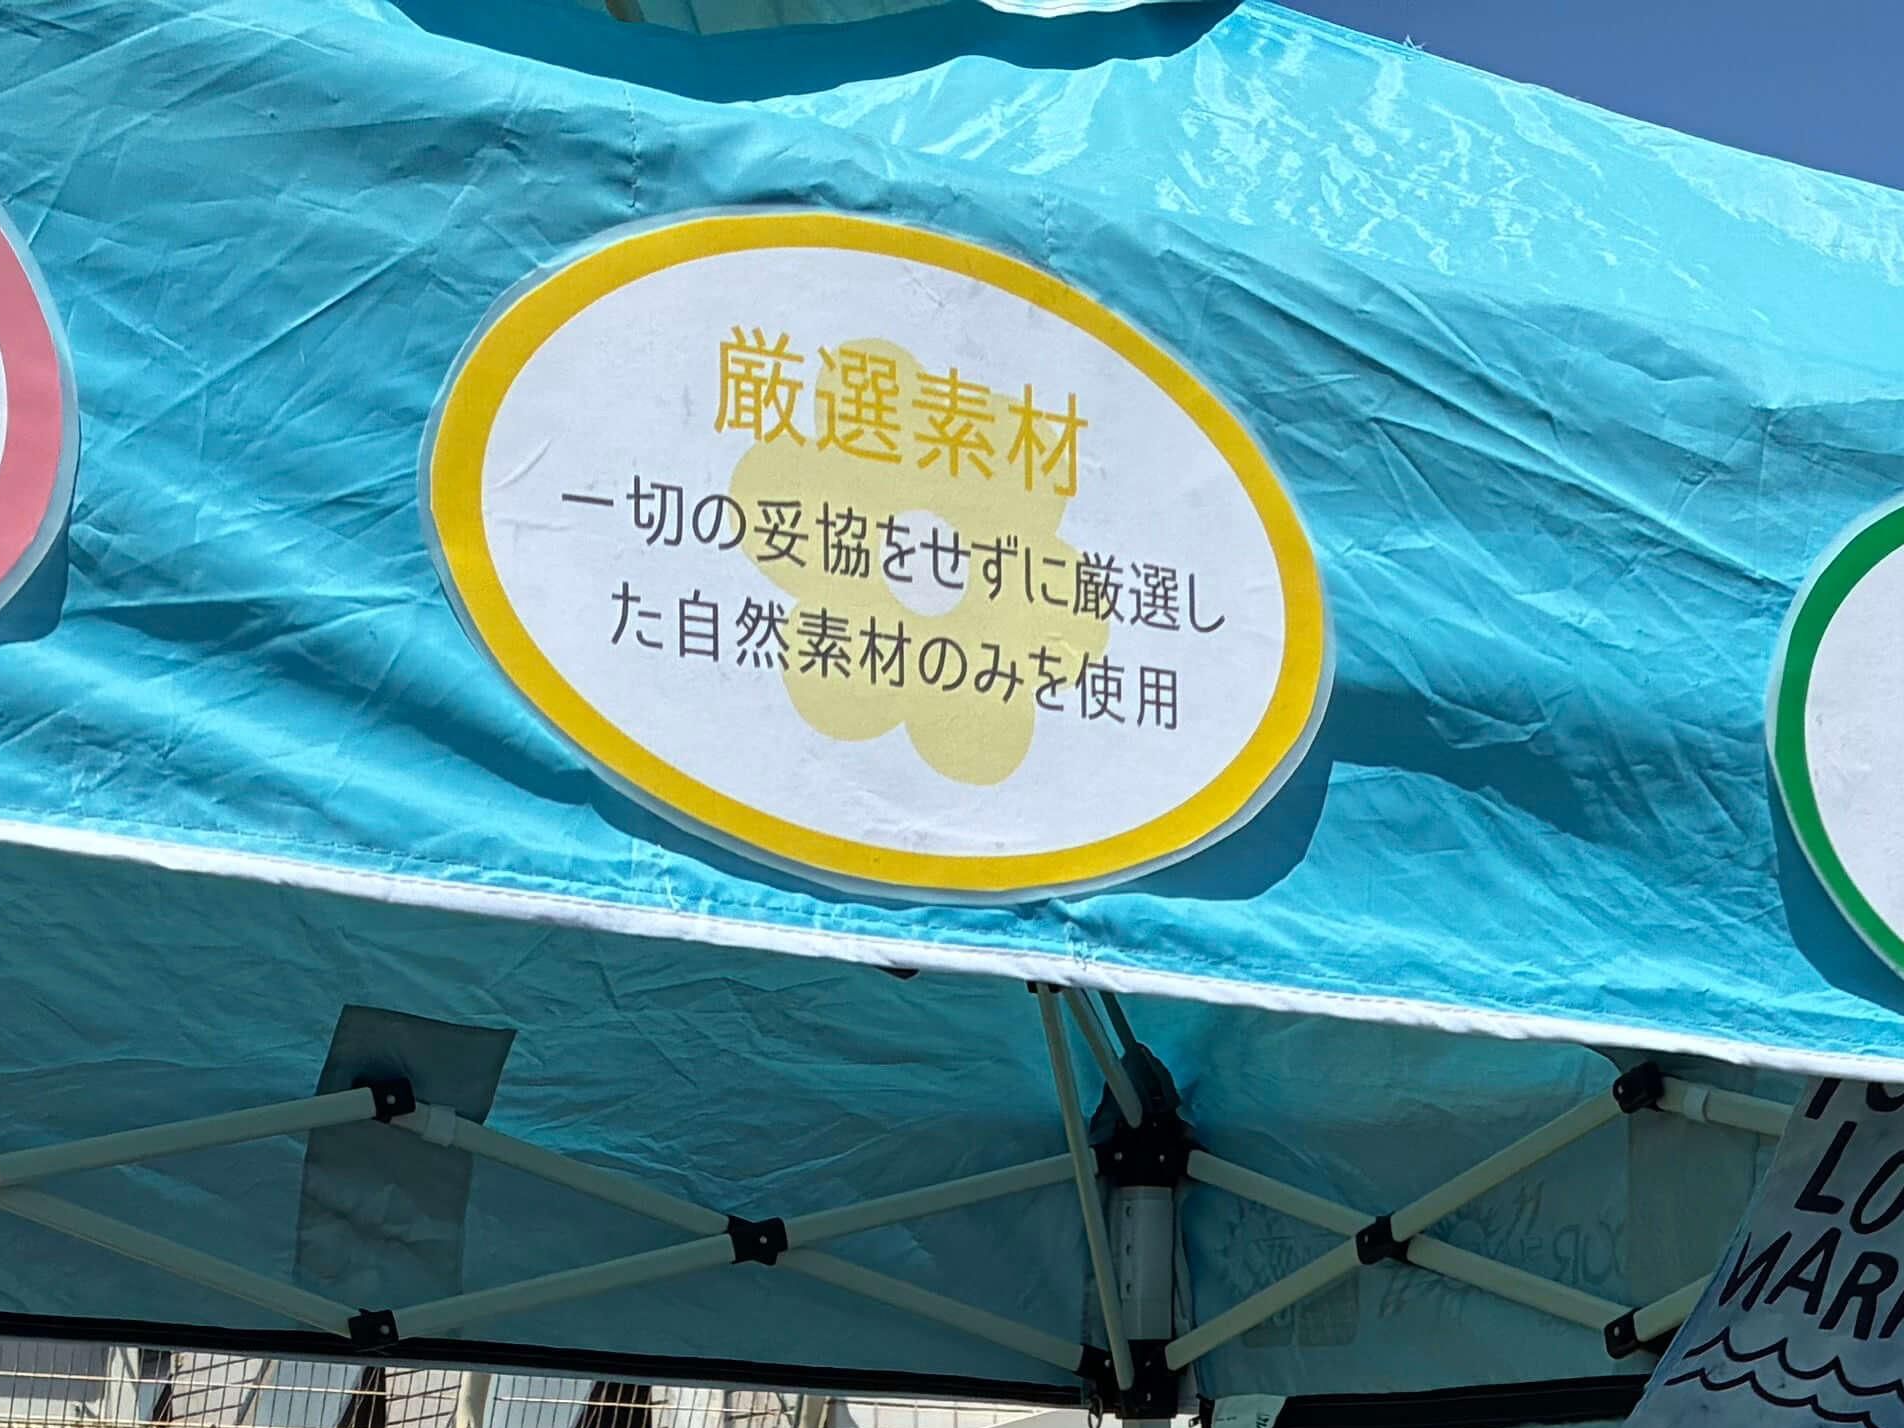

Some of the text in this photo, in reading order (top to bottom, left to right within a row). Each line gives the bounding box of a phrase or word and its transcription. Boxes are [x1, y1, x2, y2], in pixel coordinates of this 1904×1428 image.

[713, 325, 1089, 497] 厳選素材
[562, 474, 1225, 634] 一切の妥協をせずに厳選し
[610, 581, 1179, 731] た自然素材のみを使用
